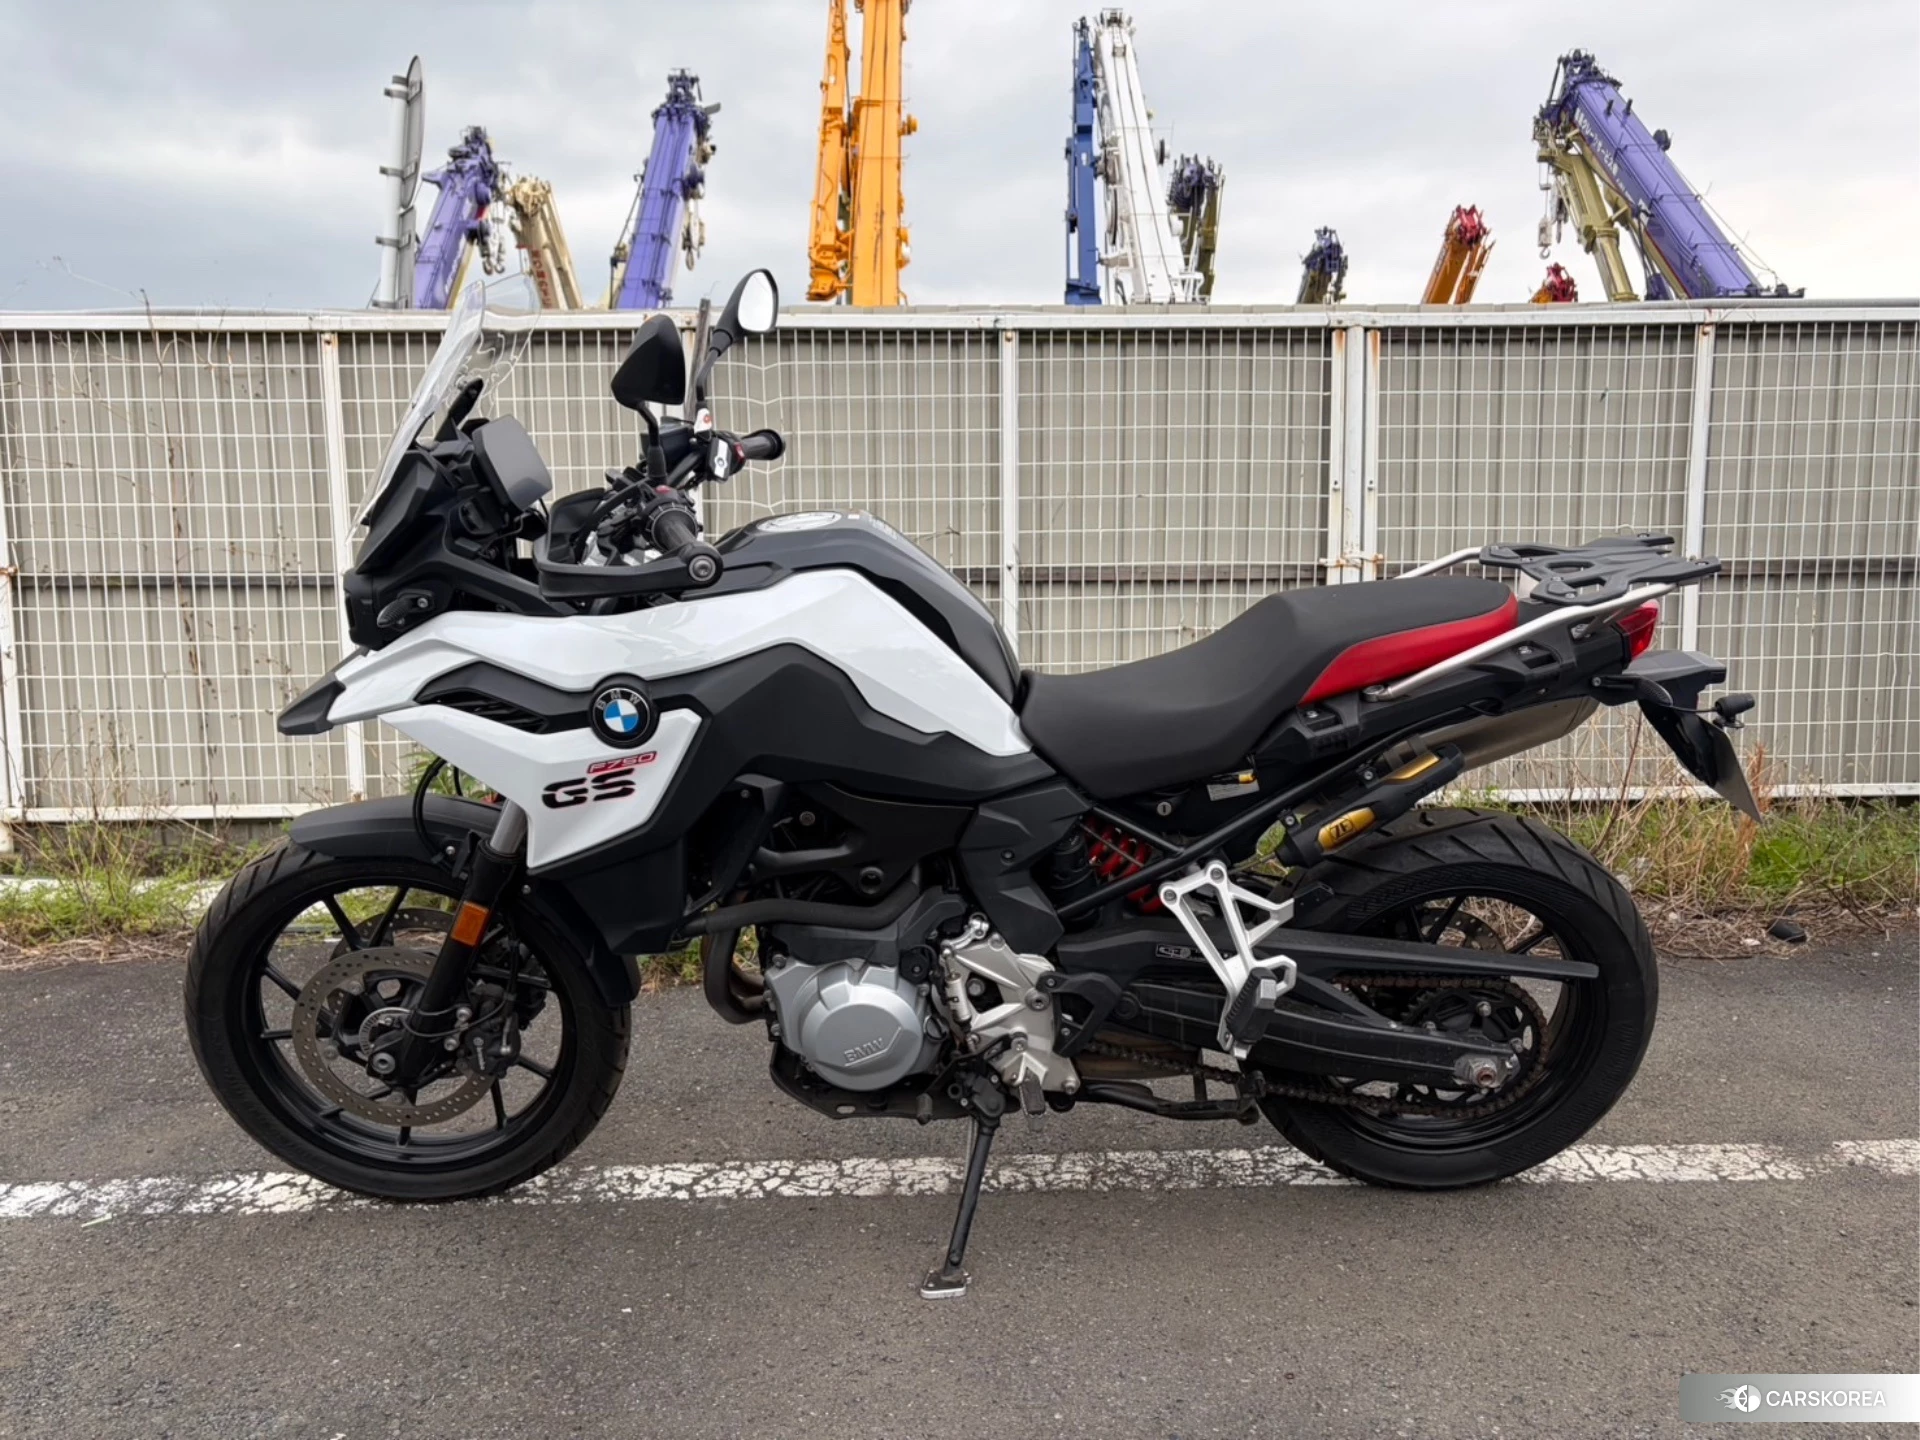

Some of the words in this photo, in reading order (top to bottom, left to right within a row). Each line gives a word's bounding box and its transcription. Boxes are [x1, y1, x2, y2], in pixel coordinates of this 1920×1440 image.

[598, 690, 640, 711] BMW
[589, 752, 656, 773] F750
[542, 768, 636, 809] GS
[844, 1037, 883, 1062] BMW
